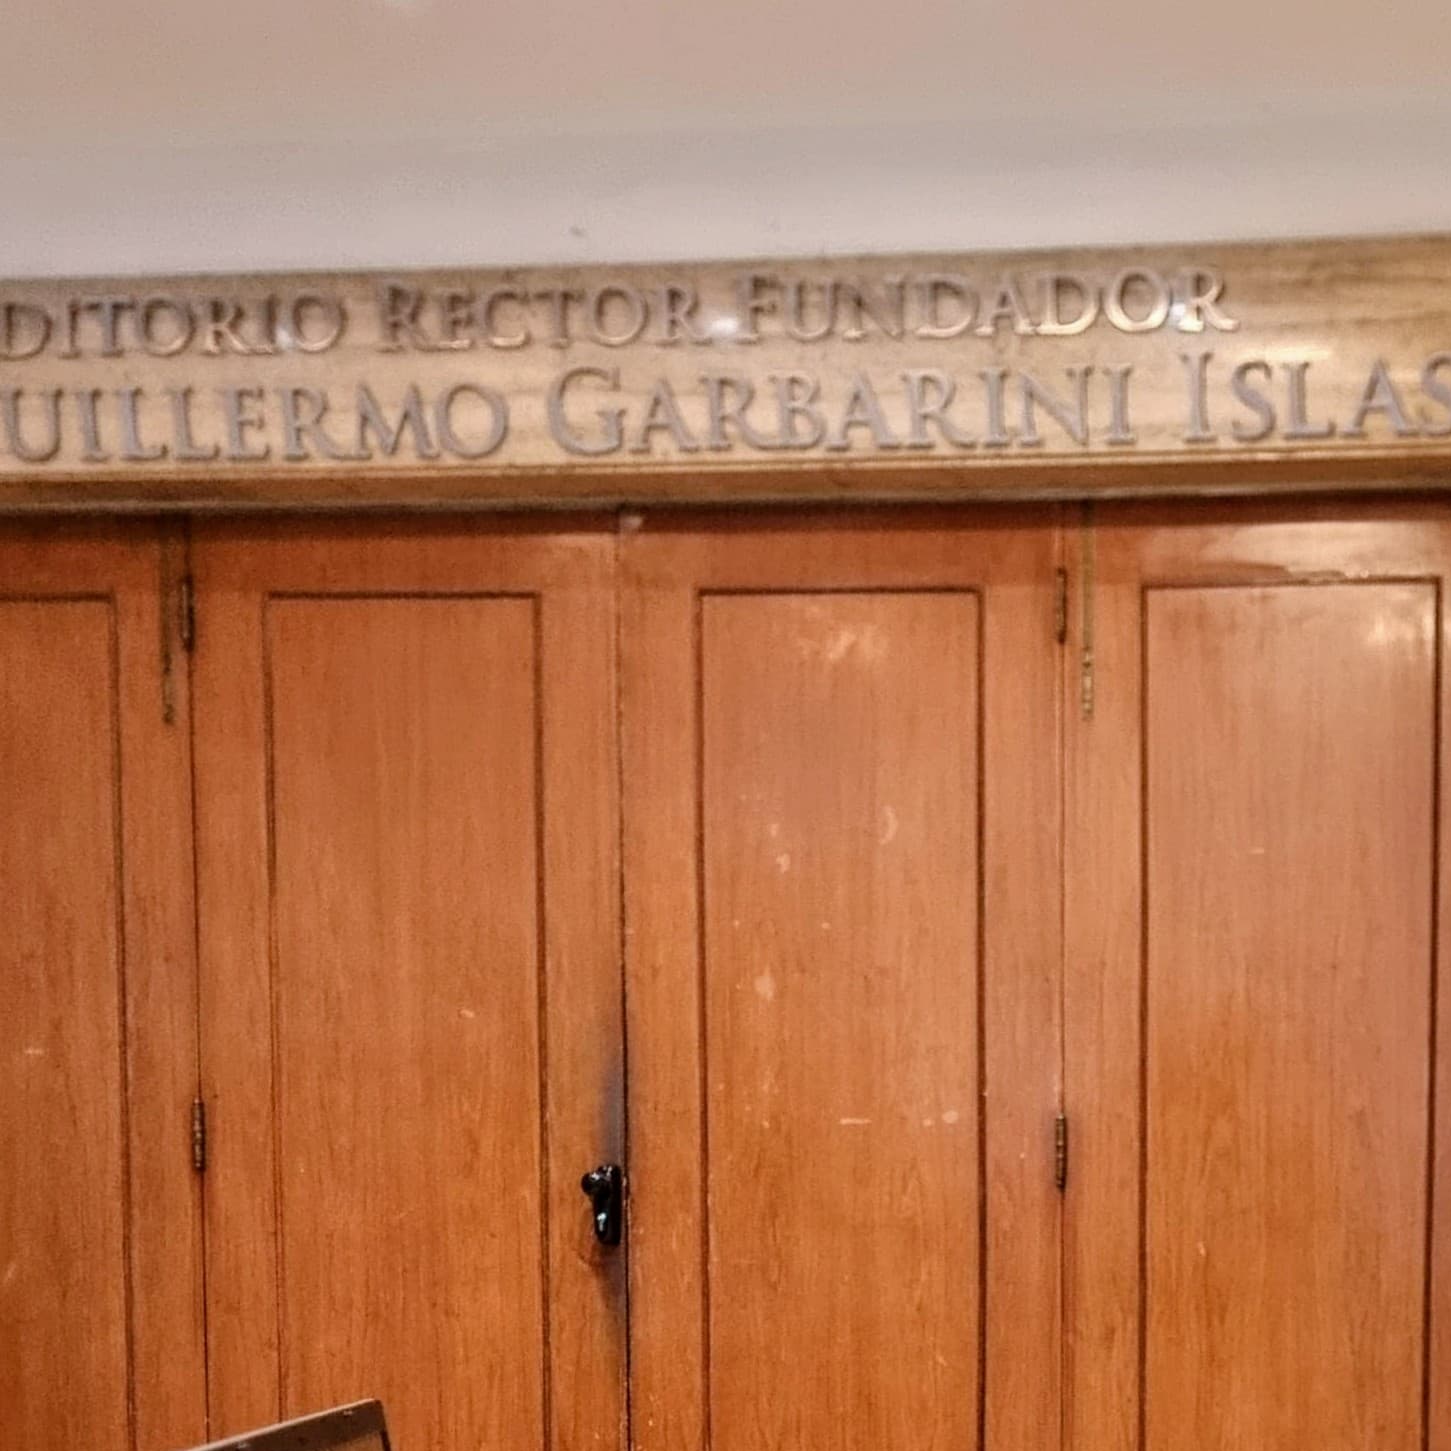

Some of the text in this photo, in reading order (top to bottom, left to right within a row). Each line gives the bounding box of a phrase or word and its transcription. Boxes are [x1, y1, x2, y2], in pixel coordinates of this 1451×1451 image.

[376, 281, 707, 355] RECTOR
[734, 263, 1241, 344] FUNDADOR
[547, 365, 1135, 459] GARBARINI
